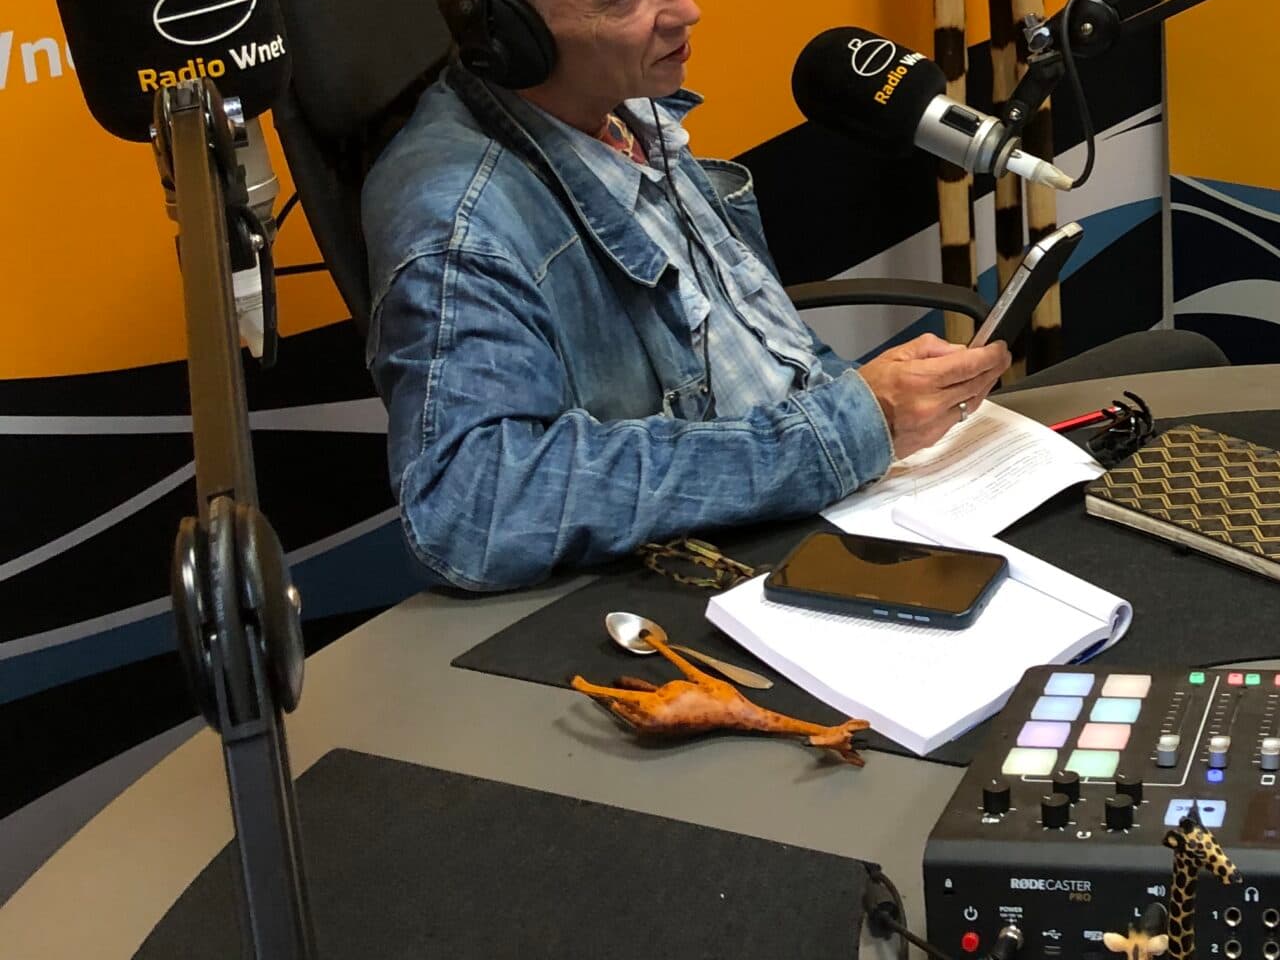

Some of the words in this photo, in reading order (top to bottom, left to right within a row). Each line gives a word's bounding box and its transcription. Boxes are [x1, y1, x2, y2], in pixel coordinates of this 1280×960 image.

[137, 57, 226, 92] Radio
[228, 34, 286, 71] Wnet
[873, 65, 908, 105] Radio
[1211, 910, 1219, 920] 1
[1211, 943, 1219, 953] 2
